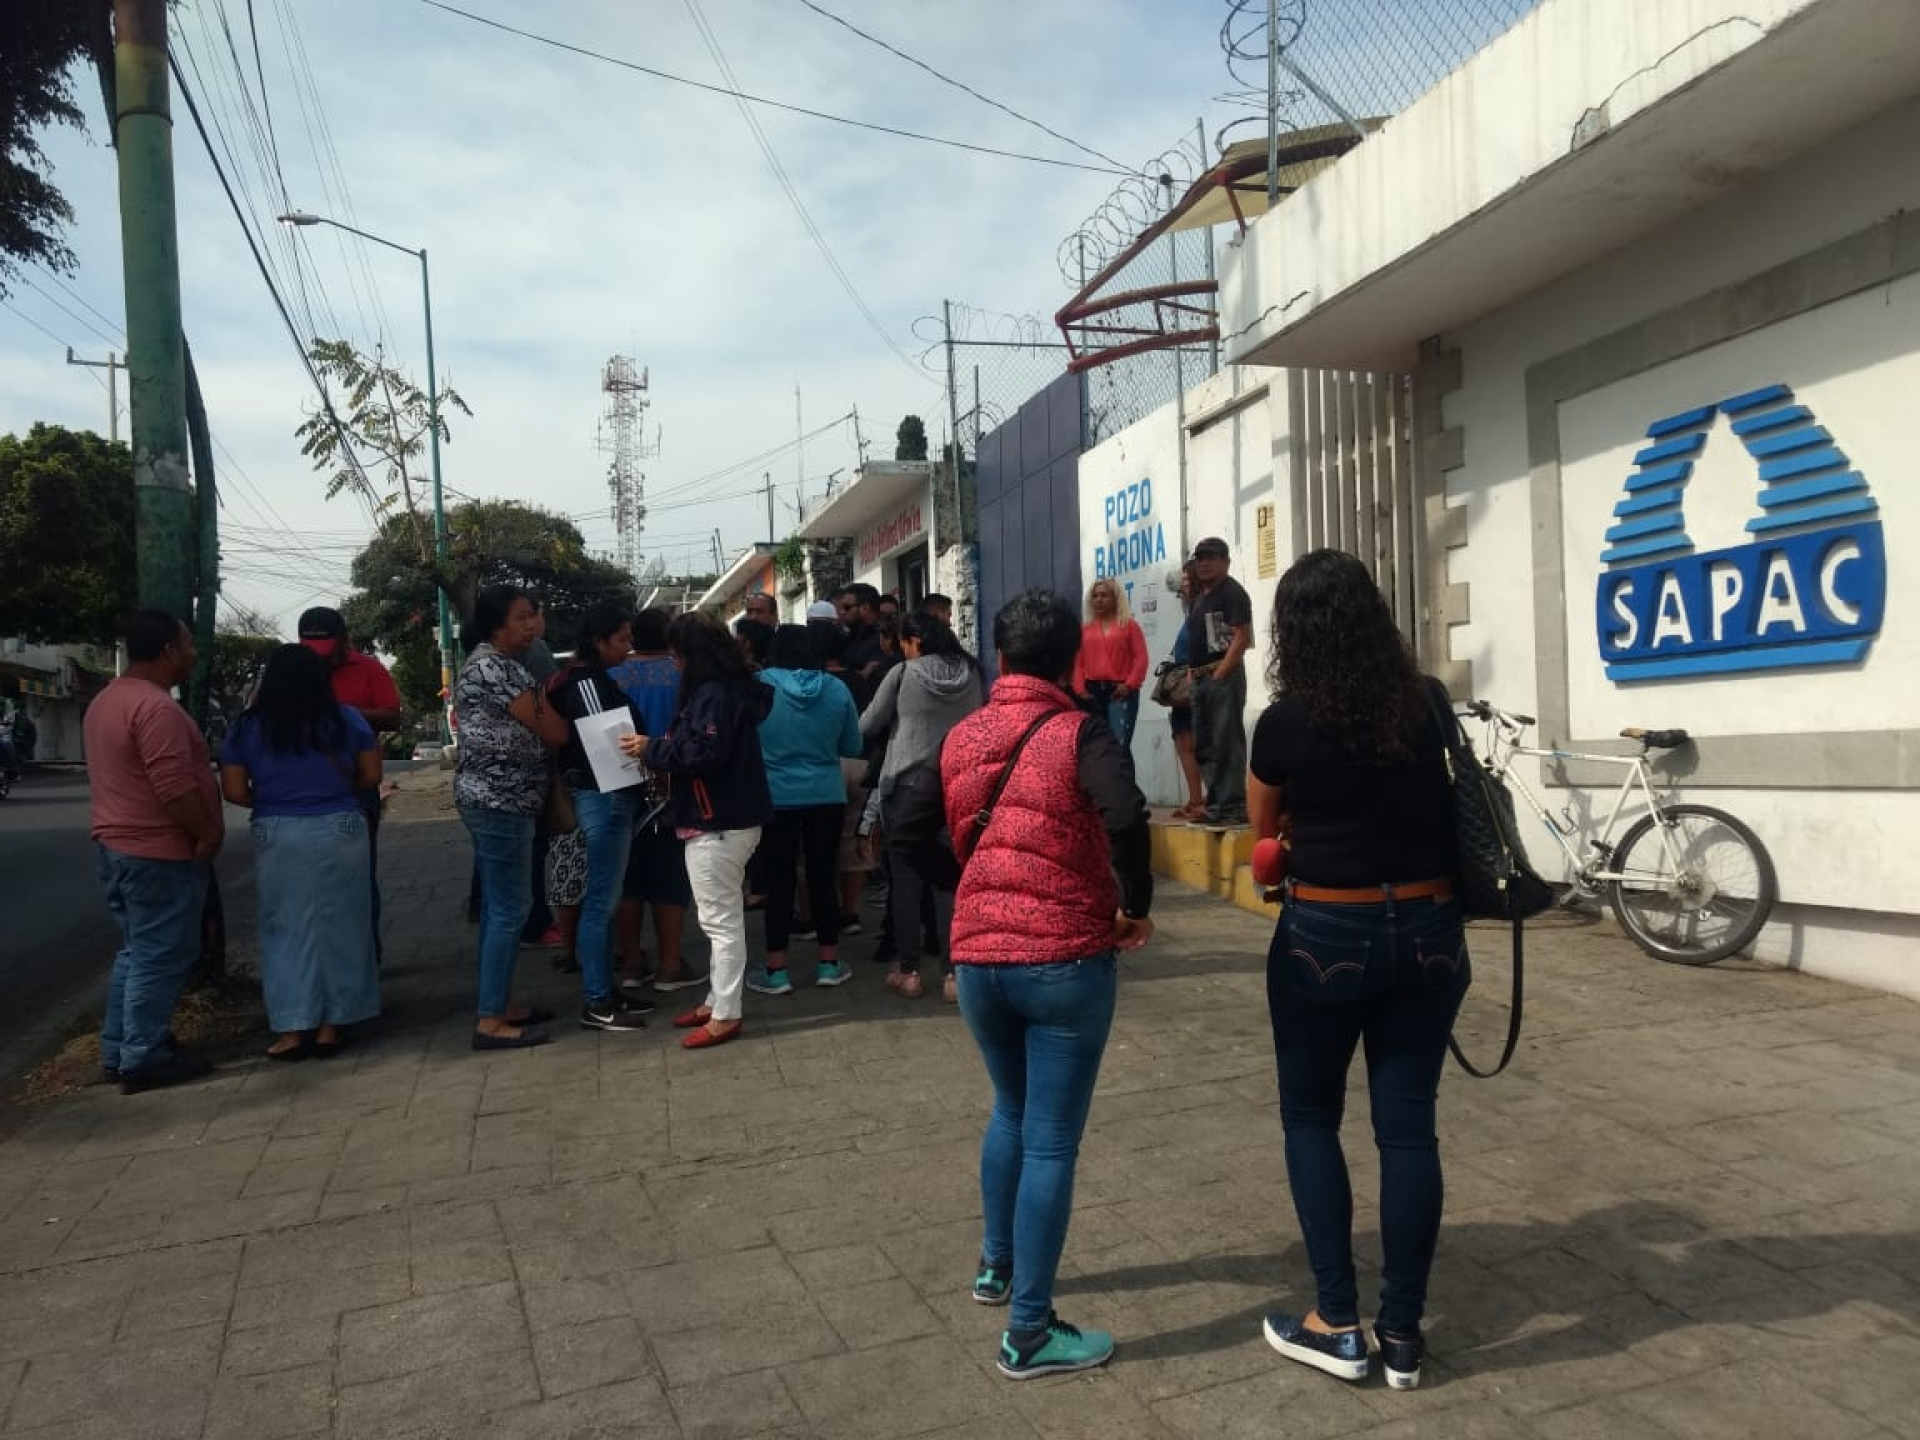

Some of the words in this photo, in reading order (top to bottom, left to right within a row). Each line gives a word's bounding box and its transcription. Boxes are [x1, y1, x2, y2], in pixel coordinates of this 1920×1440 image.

[1105, 478, 1151, 533] POZO
[1095, 522, 1165, 578] BARONA
[1613, 543, 1861, 649] SAPAC
